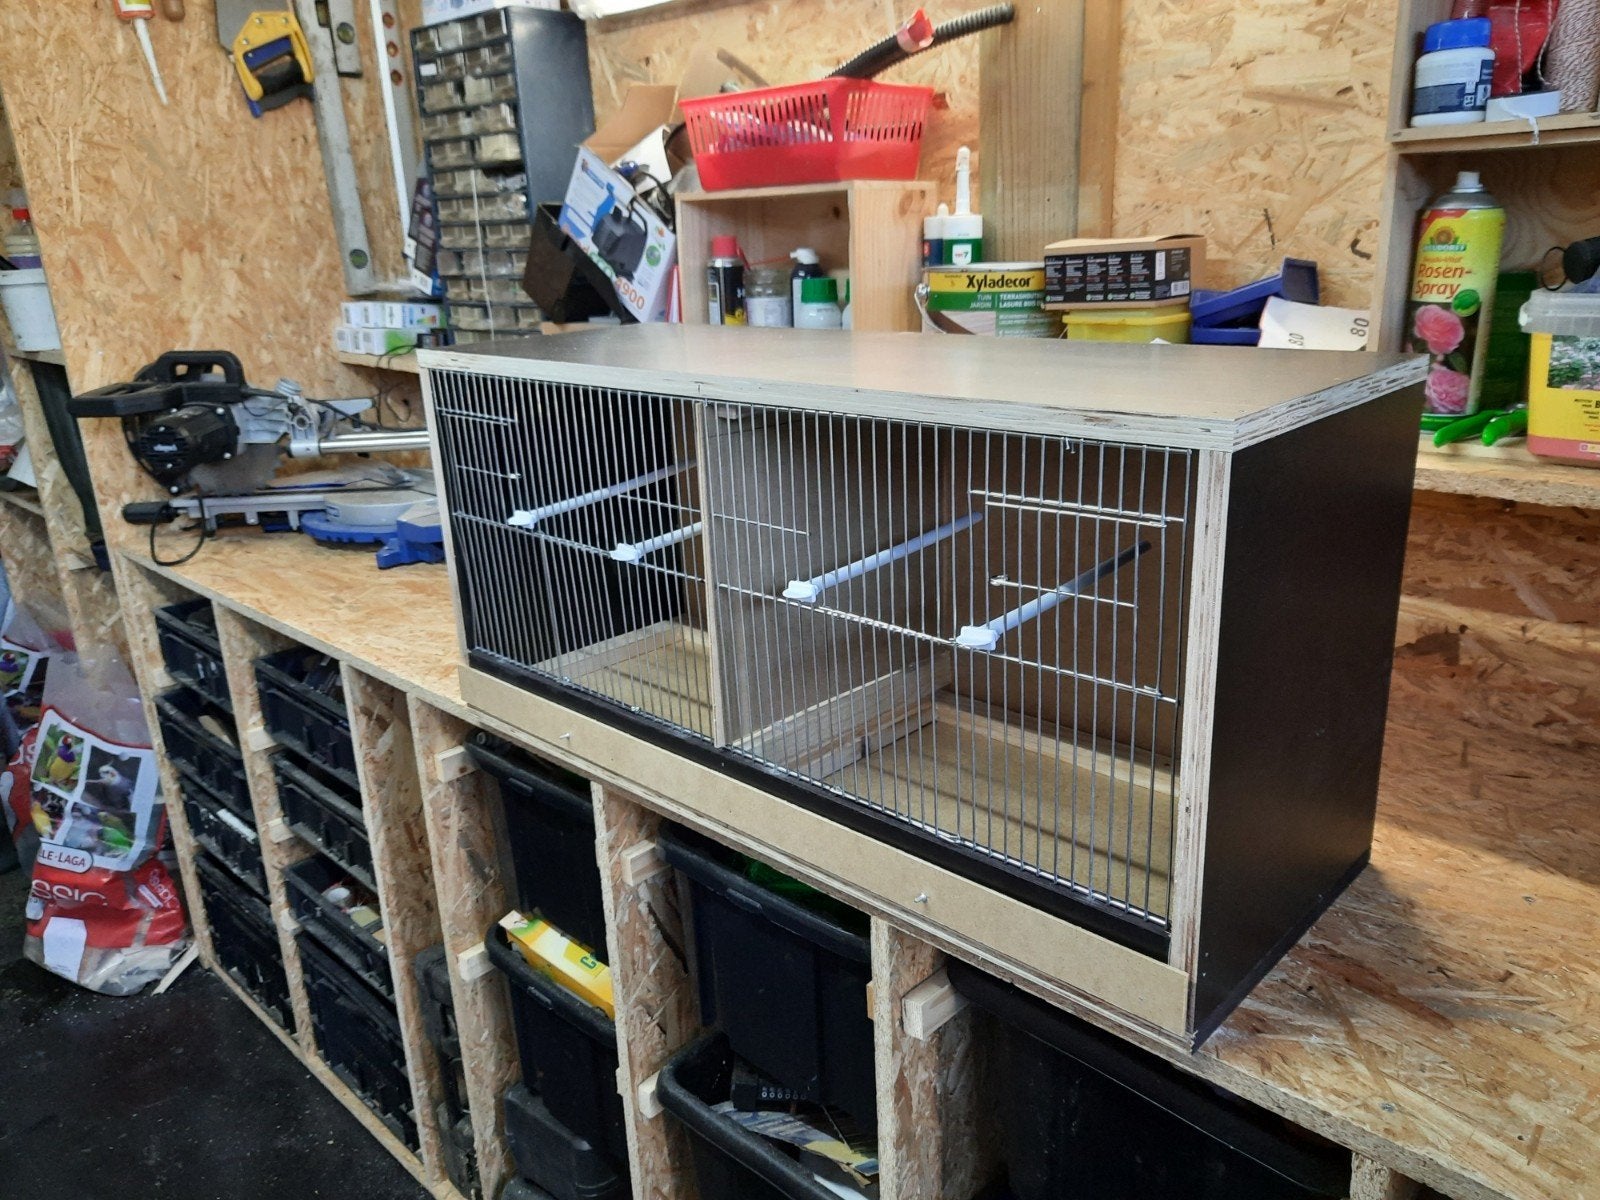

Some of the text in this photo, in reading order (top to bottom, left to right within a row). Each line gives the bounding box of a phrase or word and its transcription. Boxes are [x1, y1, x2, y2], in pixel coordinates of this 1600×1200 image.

[1418, 263, 1472, 278] Rosen-
[966, 275, 1031, 292] Xyladecor
[1415, 280, 1461, 299] Spray
[1350, 317, 1370, 337] 80
